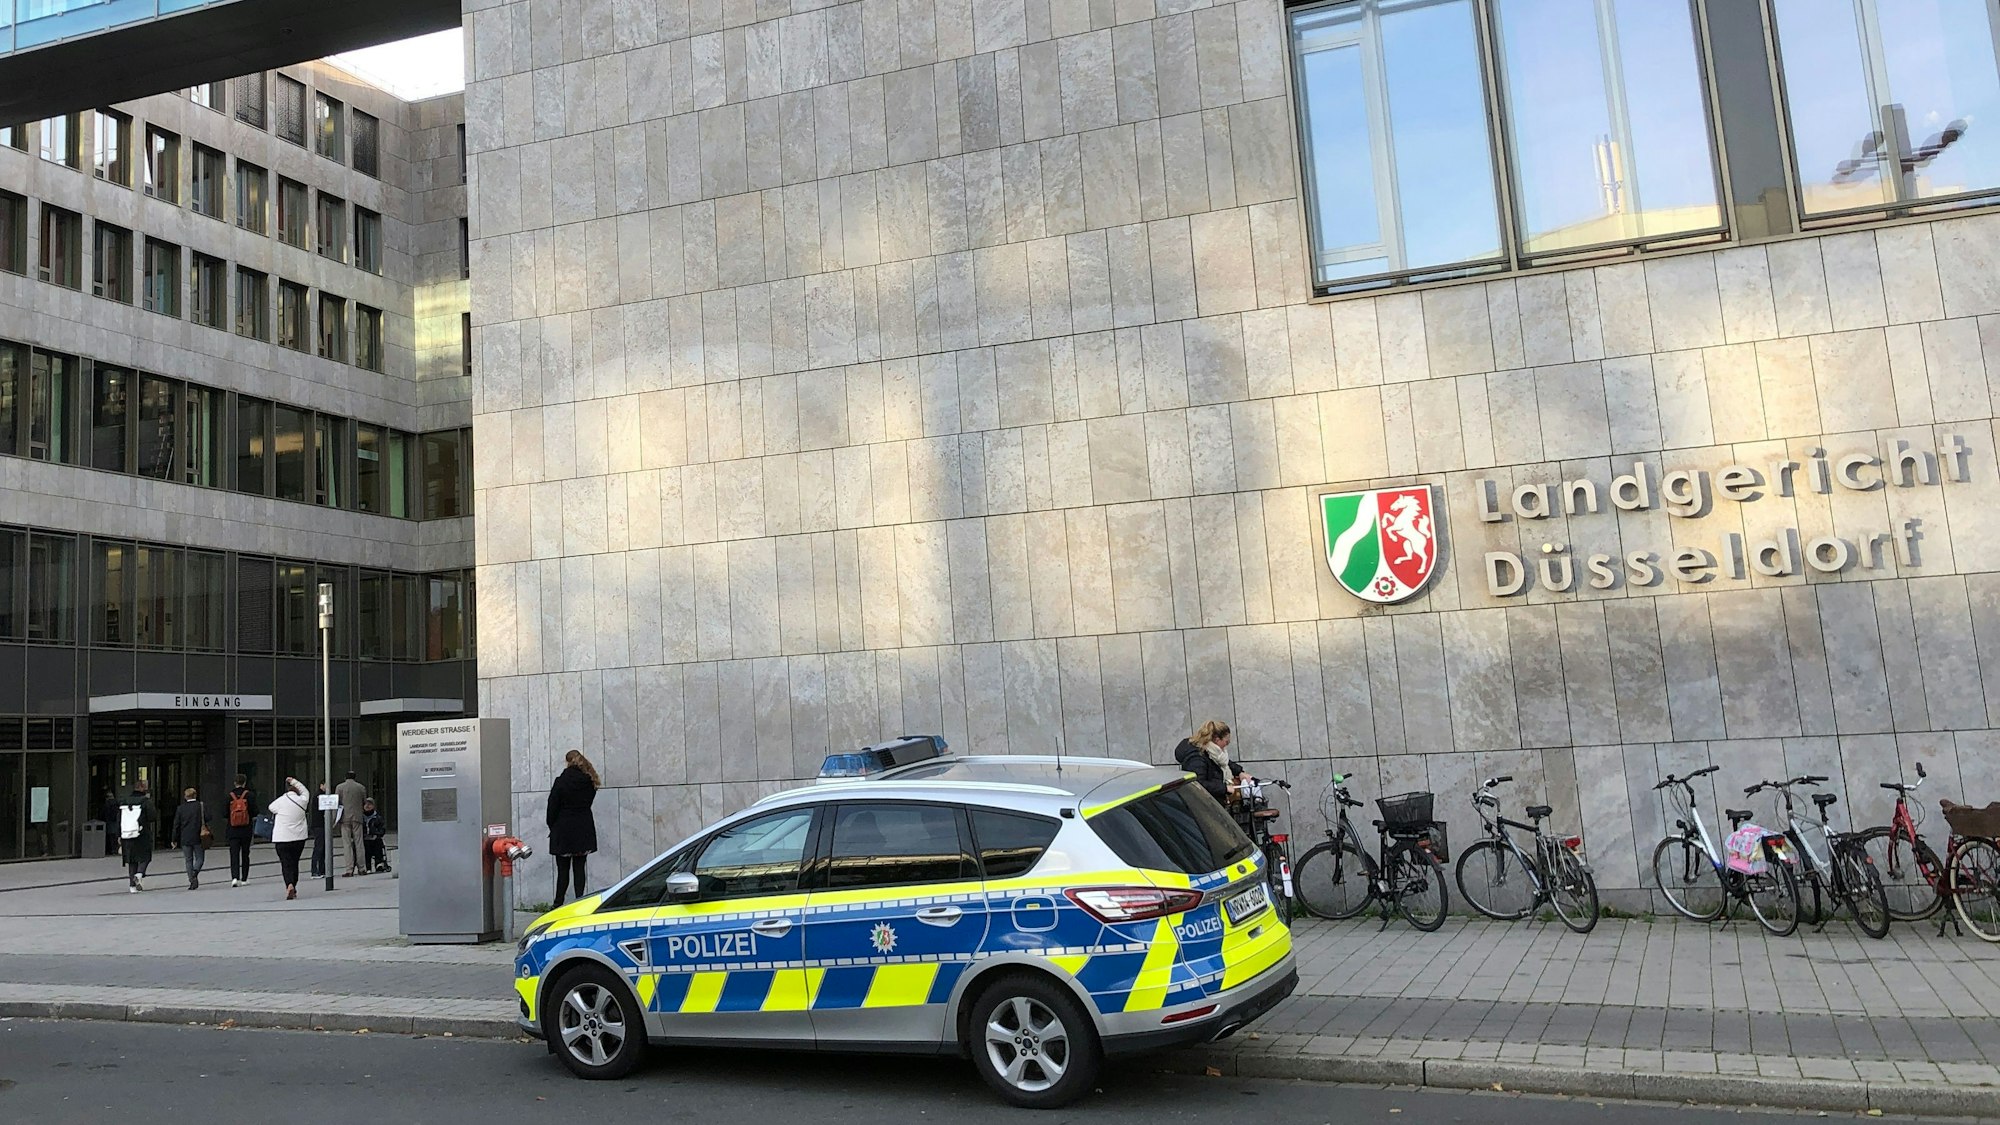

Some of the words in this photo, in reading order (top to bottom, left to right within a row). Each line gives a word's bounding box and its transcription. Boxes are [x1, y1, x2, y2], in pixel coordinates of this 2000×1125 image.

[1475, 433, 1965, 522] Landgericht
[1484, 519, 1919, 597] Düsseldorf
[175, 696, 241, 707] EINGANG
[401, 727, 438, 736] WERDENER
[440, 725, 470, 734] STRASSE
[1176, 916, 1222, 941] POLIZEI
[668, 932, 757, 959] POLIZEI
